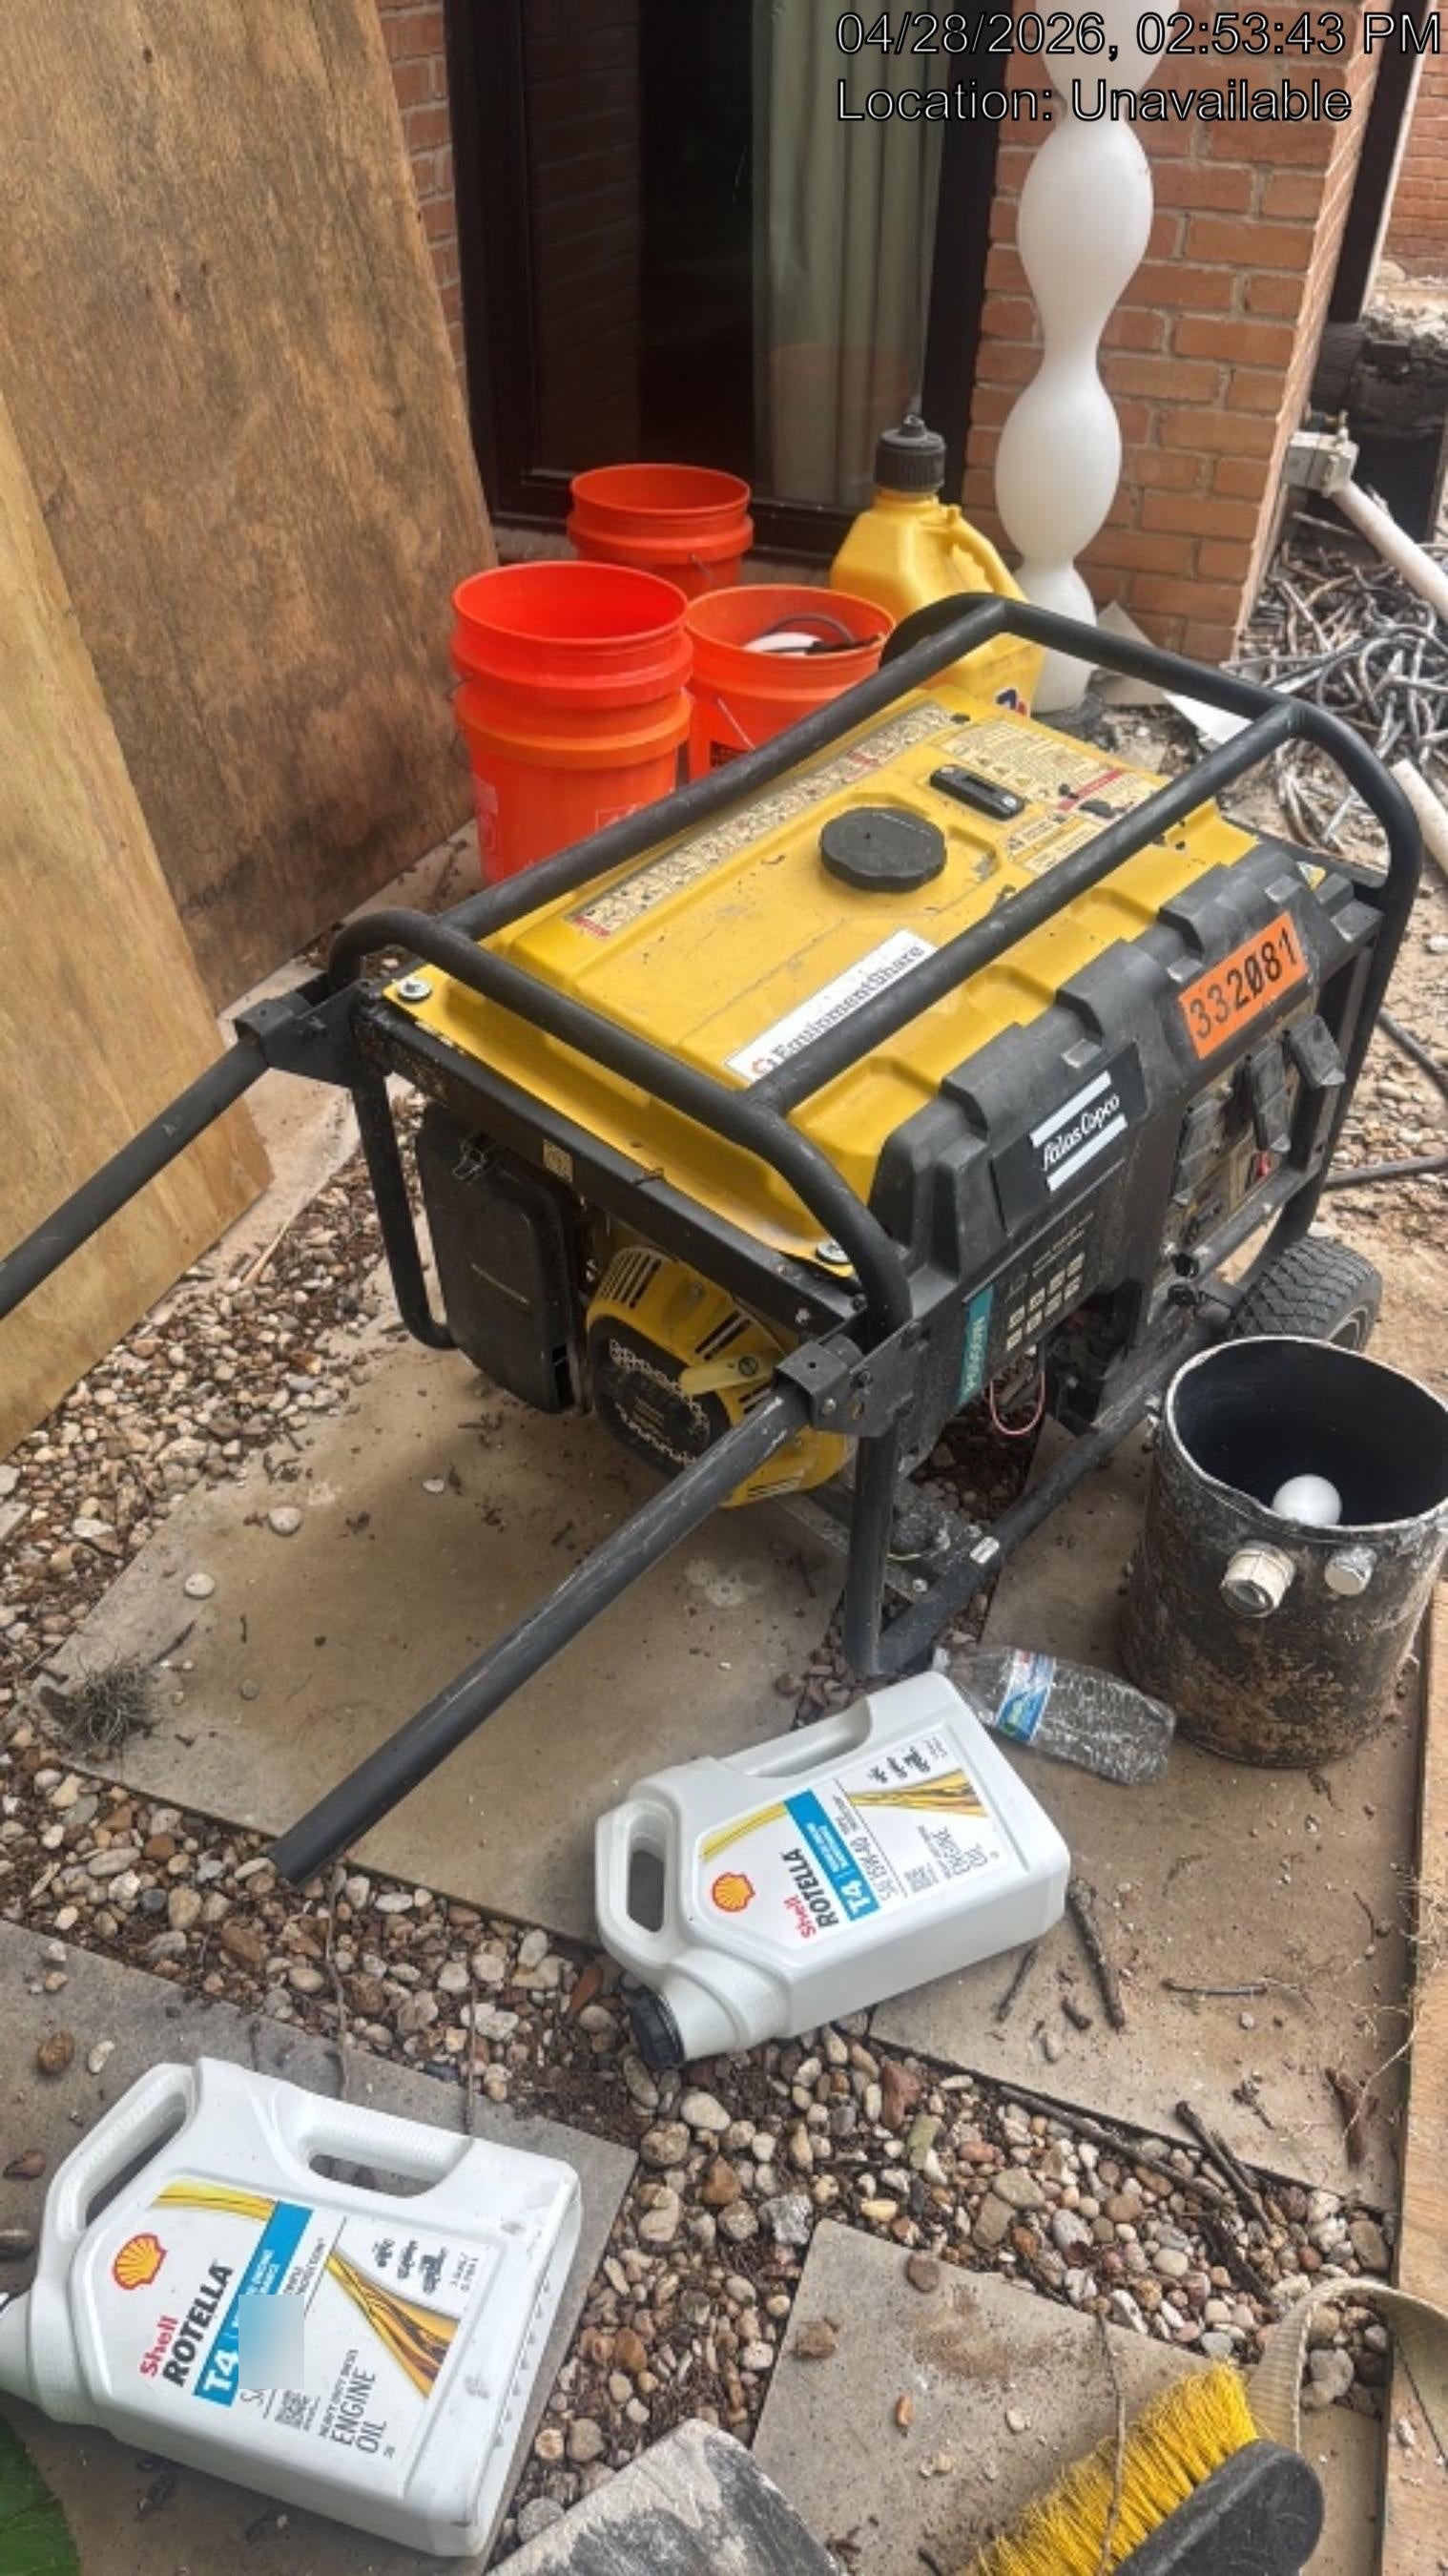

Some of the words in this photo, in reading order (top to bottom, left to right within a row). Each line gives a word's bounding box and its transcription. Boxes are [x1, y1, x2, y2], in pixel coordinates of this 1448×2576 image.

[1190, 927, 1298, 1039] 332081
[1080, 1093, 1121, 1133] Copco
[782, 1848, 839, 1928] ROTELLA
[840, 1880, 872, 1915] T4
[784, 1895, 817, 1939] Shell
[139, 2315, 179, 2377] Shell
[162, 2263, 234, 2387] ROTELLA
[203, 2348, 239, 2391] T4
[329, 2366, 376, 2447] ENGINE
[355, 2420, 387, 2454] OIL
